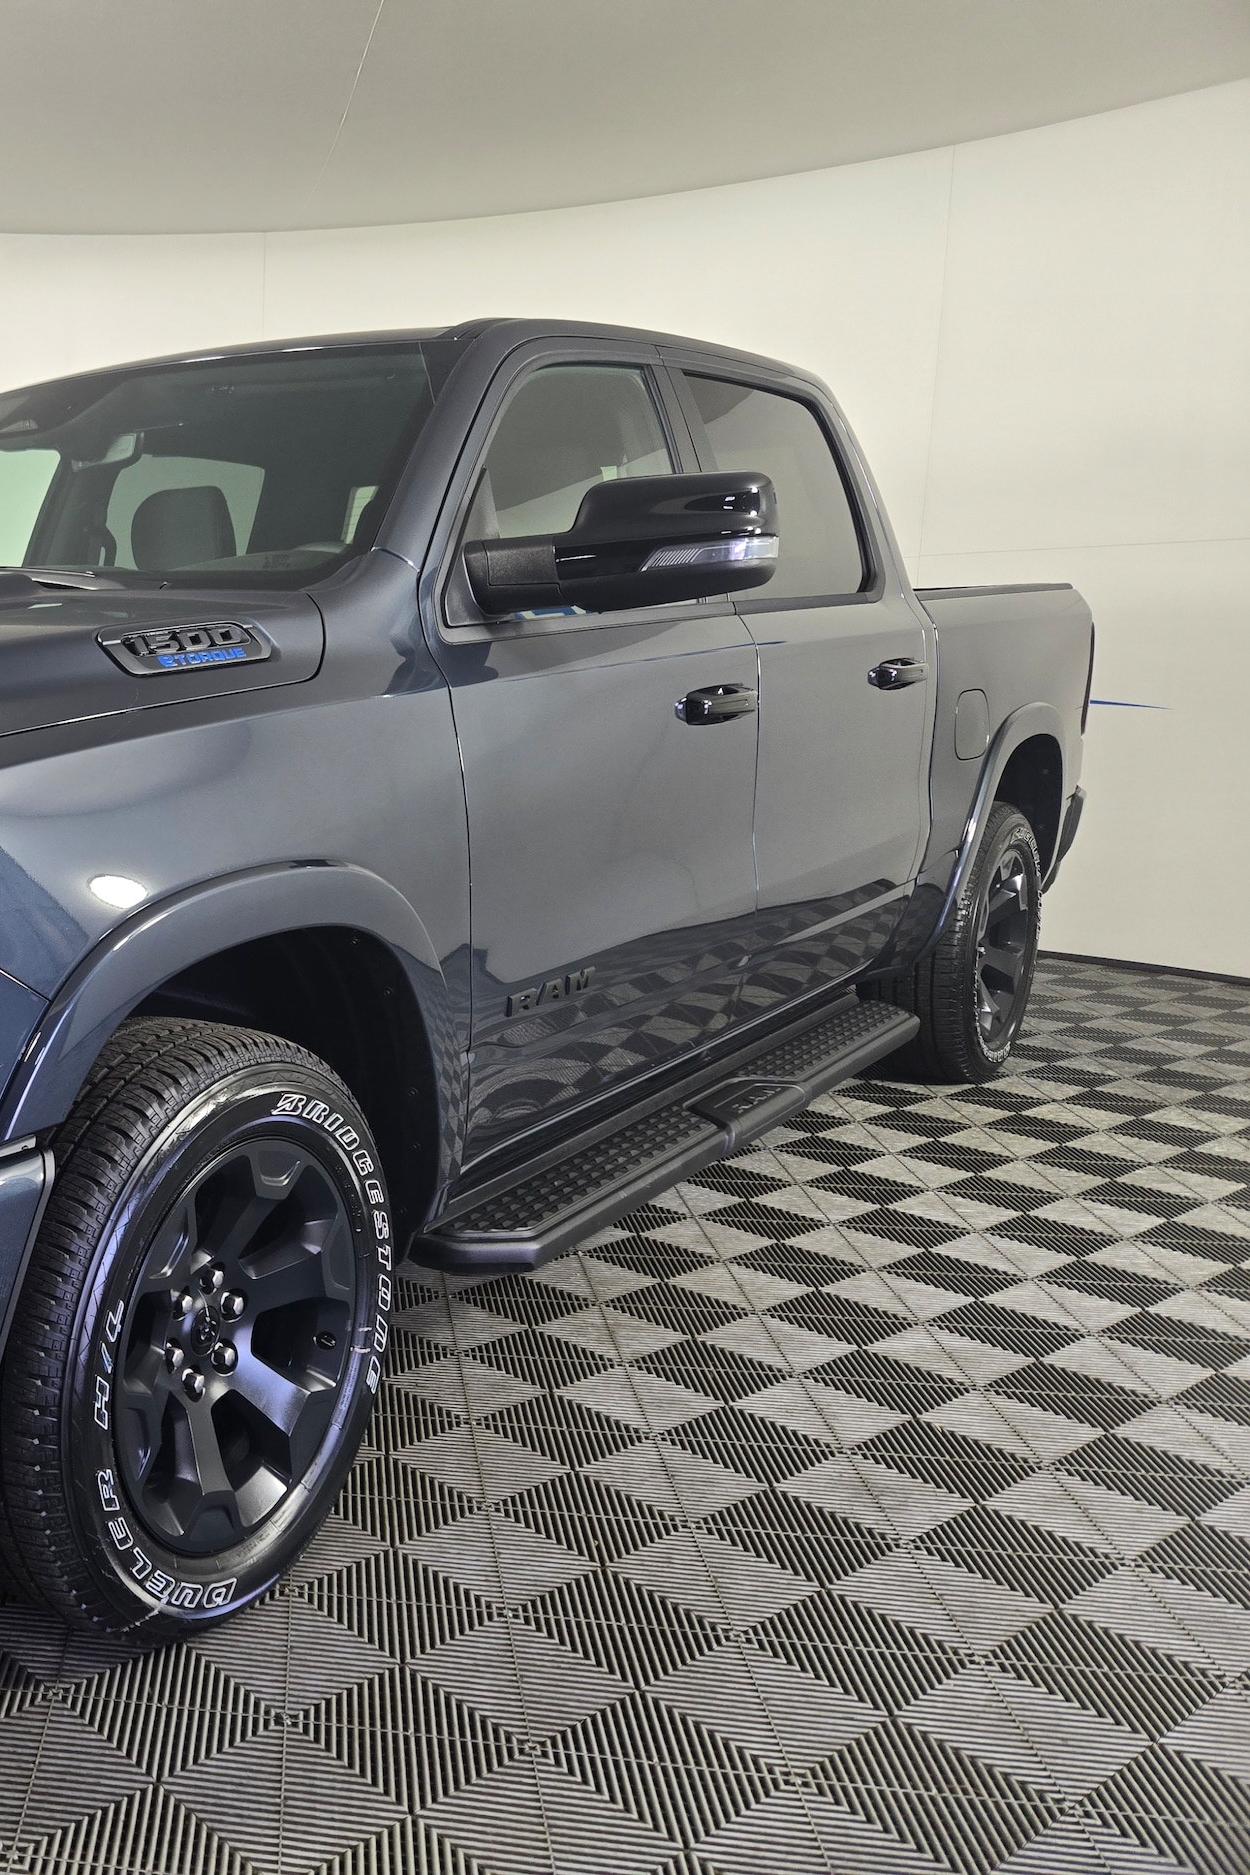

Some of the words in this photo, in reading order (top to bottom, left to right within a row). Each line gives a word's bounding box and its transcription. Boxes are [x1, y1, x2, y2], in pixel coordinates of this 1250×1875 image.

[125, 627, 242, 656] 1500
[506, 966, 596, 1018] RAM
[269, 1092, 394, 1396] BRIDGESTONE
[95, 1468, 238, 1609] DUELER
